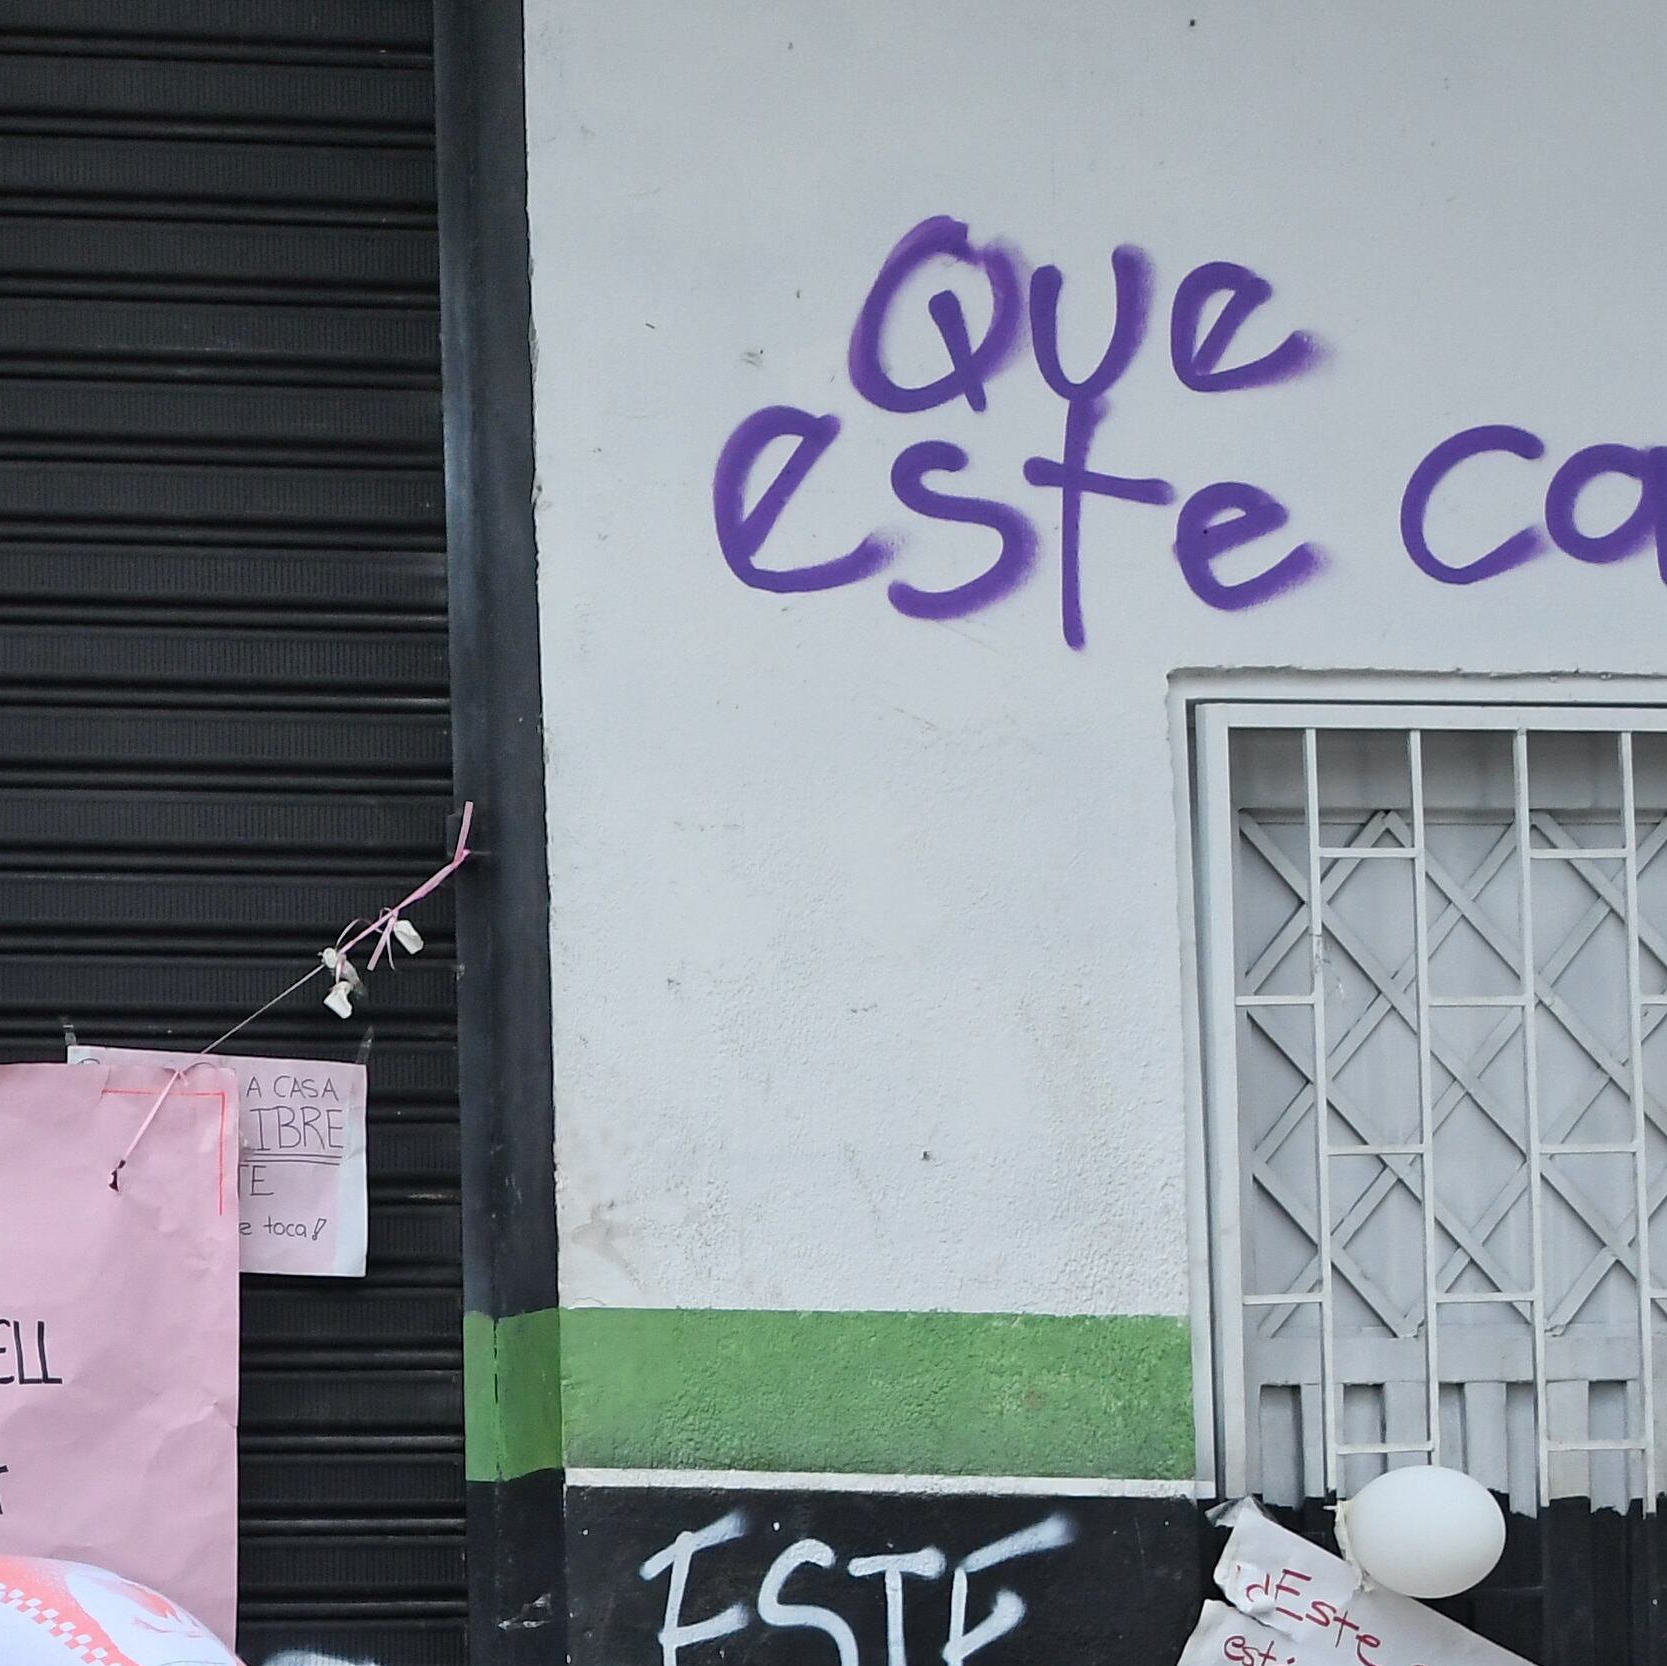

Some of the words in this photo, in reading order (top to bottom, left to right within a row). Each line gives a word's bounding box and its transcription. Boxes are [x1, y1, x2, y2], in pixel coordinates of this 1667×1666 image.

[848, 213, 1329, 413] Que
[713, 400, 1329, 651] este
[1400, 424, 1667, 586] ca
[272, 1074, 340, 1102] CASA
[248, 1105, 345, 1152] IBRE
[238, 1221, 253, 1237] e
[263, 1215, 328, 1242] toca!
